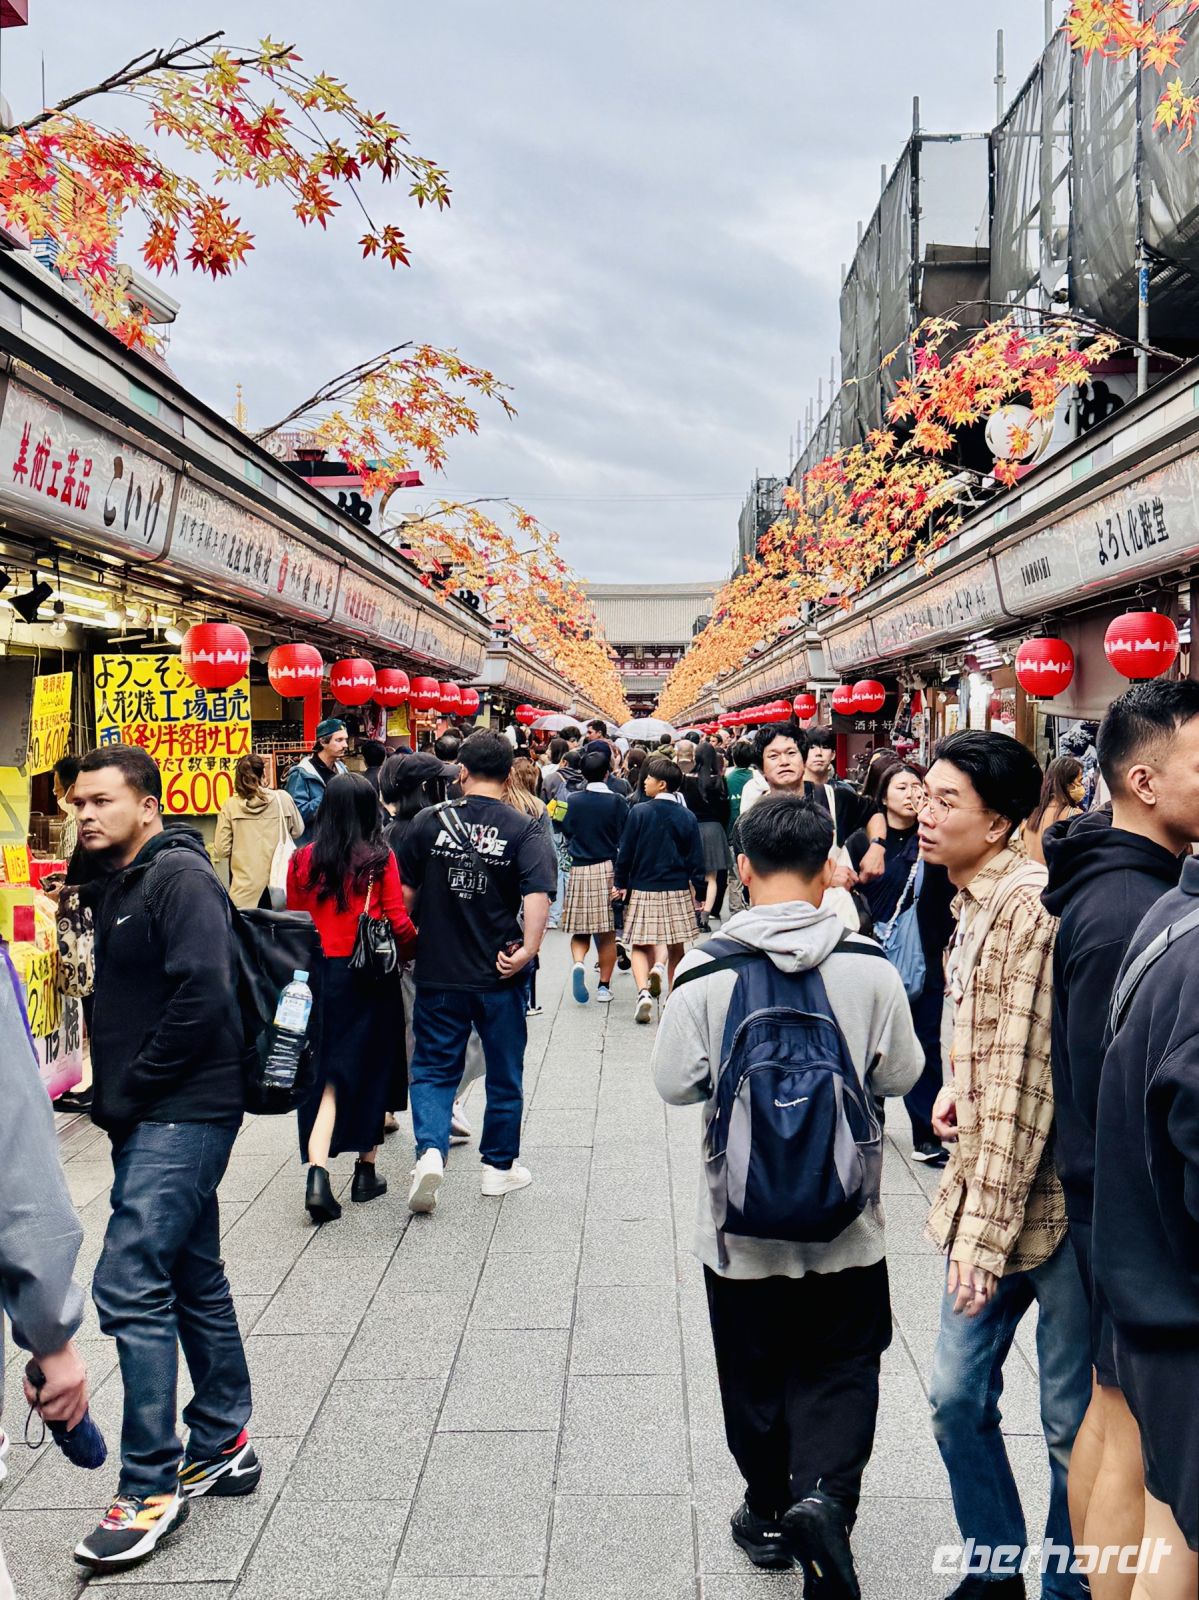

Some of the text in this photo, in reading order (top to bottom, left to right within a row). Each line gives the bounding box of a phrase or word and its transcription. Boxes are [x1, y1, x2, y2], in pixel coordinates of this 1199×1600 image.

[13, 421, 92, 510] 美術工芸品
[1096, 496, 1169, 566] よろし化粧堂
[97, 688, 250, 723] 人形焼工場直売
[100, 723, 249, 756] 雨降り半額サービス
[455, 822, 499, 841] KYO
